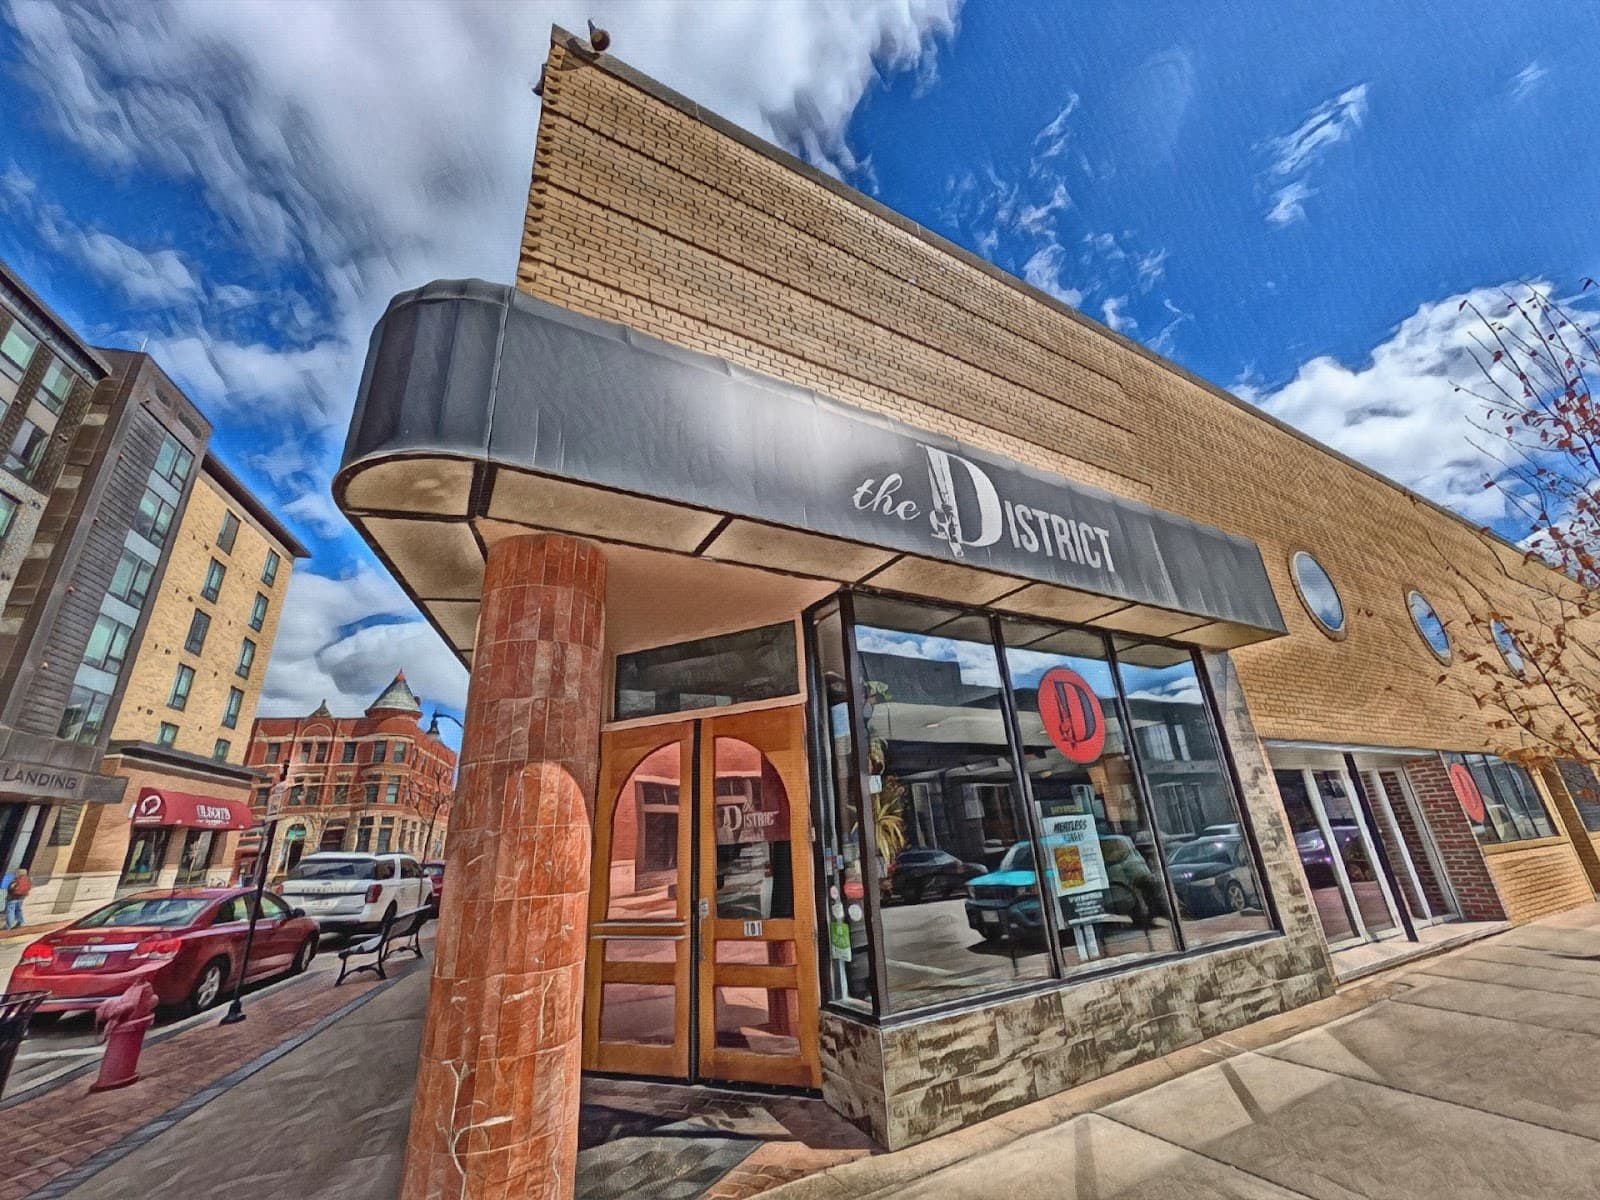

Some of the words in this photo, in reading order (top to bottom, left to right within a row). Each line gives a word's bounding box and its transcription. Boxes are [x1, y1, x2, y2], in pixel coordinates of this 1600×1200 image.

[852, 473, 921, 521] the
[916, 442, 1115, 572] DISTRICT
[2, 767, 78, 790] LANDING
[1053, 819, 1088, 834] MEATLESS
